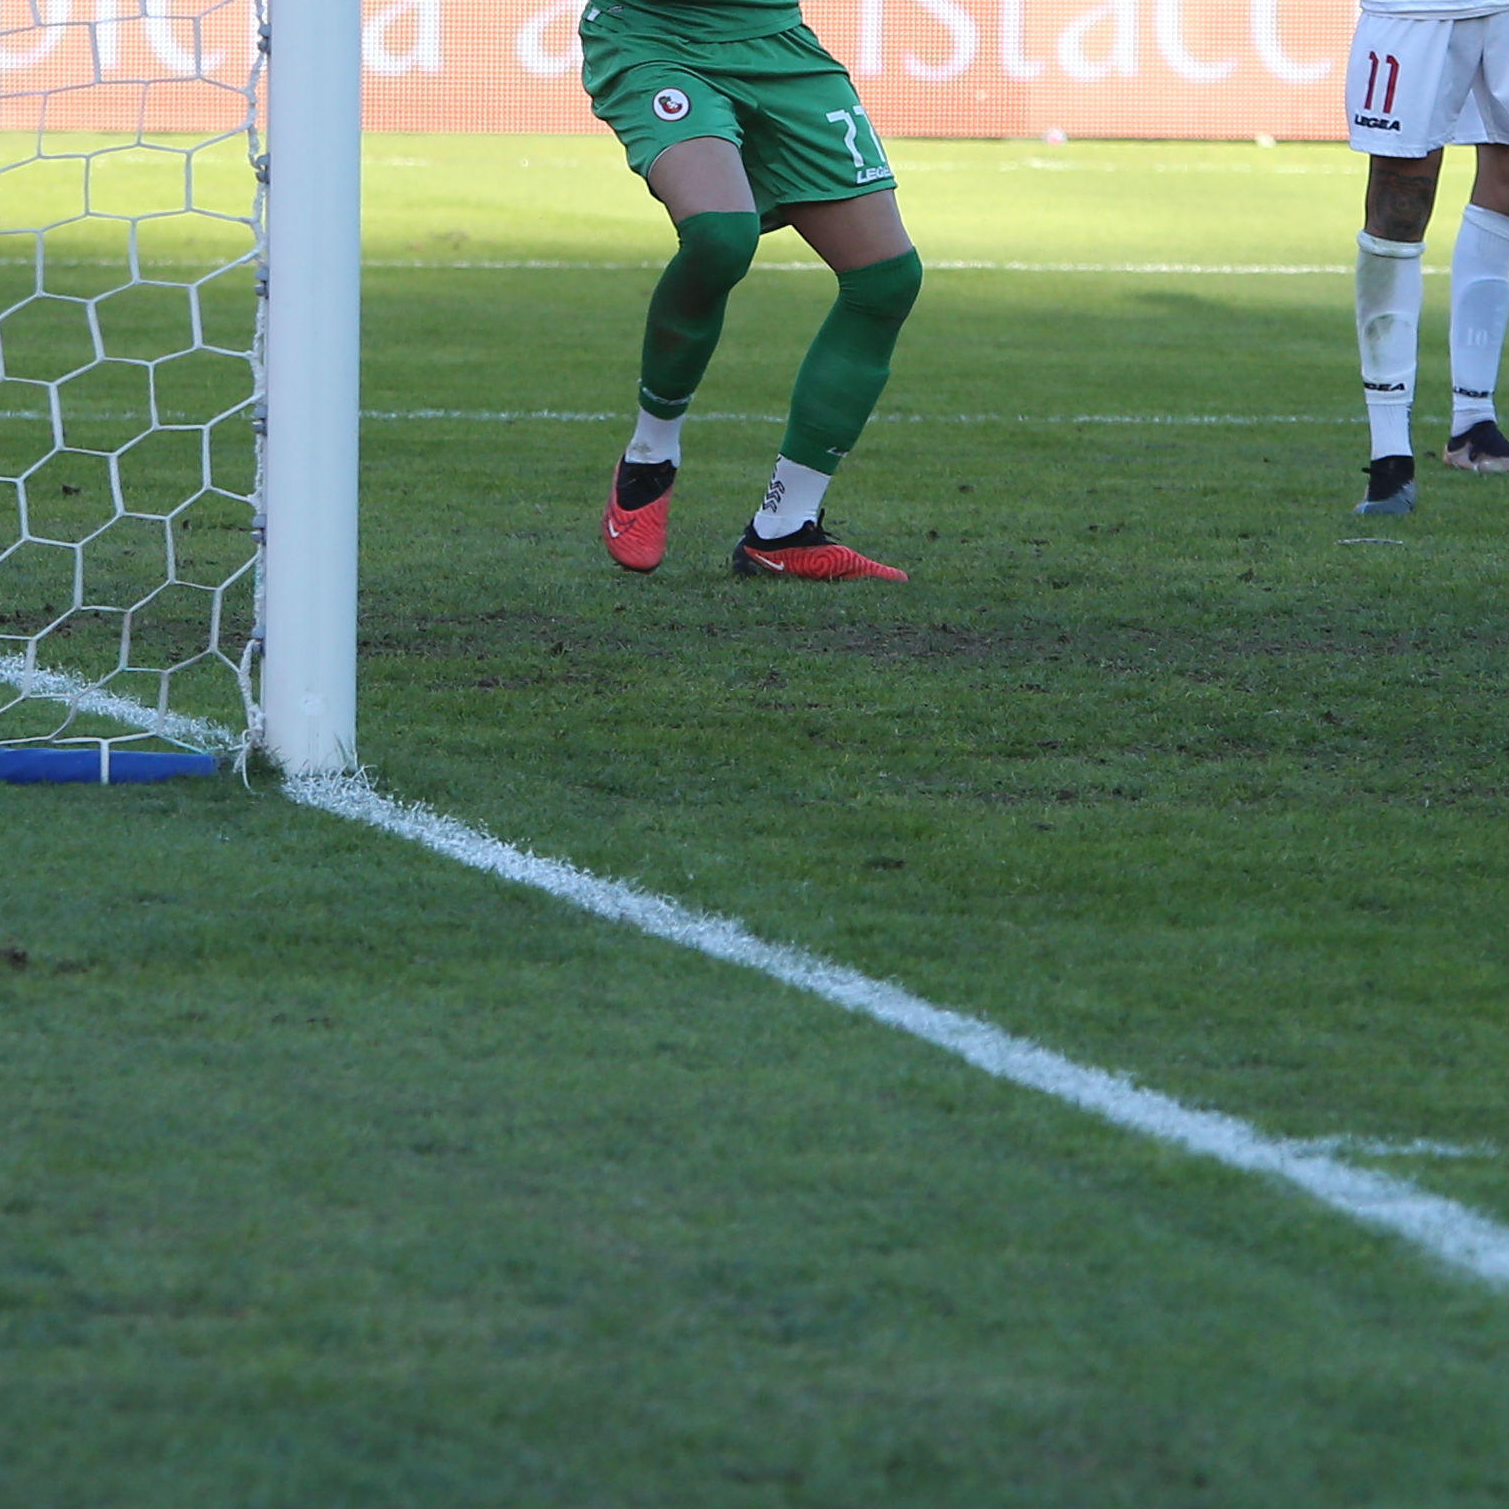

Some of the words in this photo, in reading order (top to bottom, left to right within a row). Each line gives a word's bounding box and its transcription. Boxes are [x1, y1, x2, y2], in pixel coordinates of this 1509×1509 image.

[1363, 50, 1400, 114] 11
[1354, 113, 1401, 132] LEGEA
[856, 165, 895, 184] LEGE
